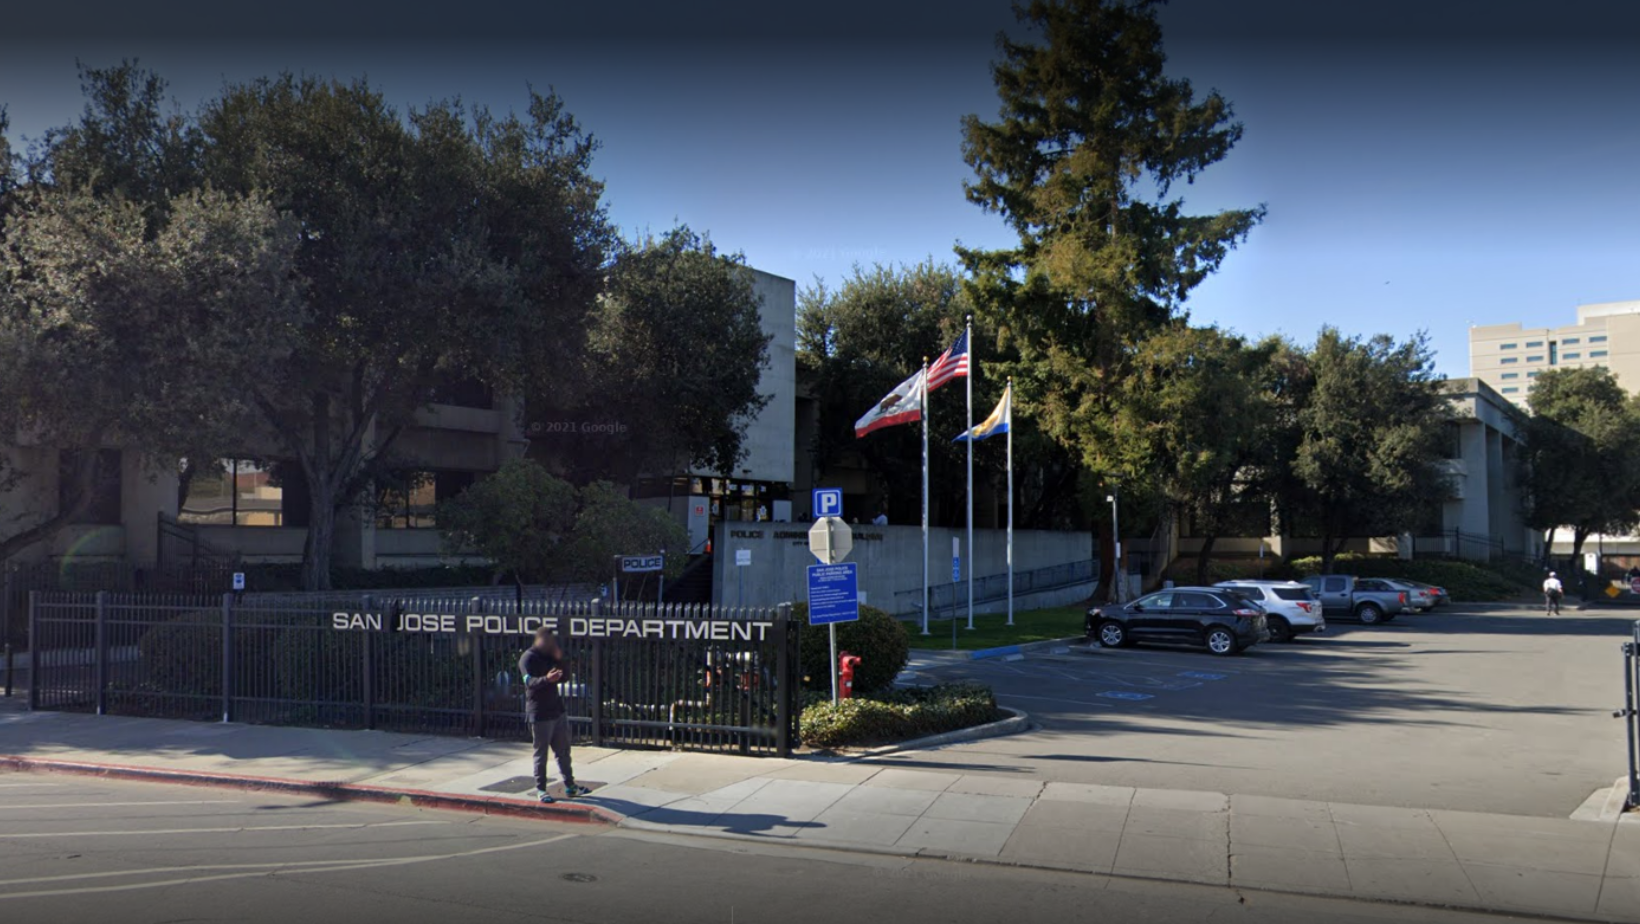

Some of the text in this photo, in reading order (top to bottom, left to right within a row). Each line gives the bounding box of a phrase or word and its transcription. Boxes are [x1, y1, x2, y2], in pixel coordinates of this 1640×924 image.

[821, 493, 837, 513] P
[730, 530, 764, 539] POLICE
[623, 558, 661, 569] POLICE
[332, 612, 774, 642] SAN JOSE POLICE DEPARTMENT
